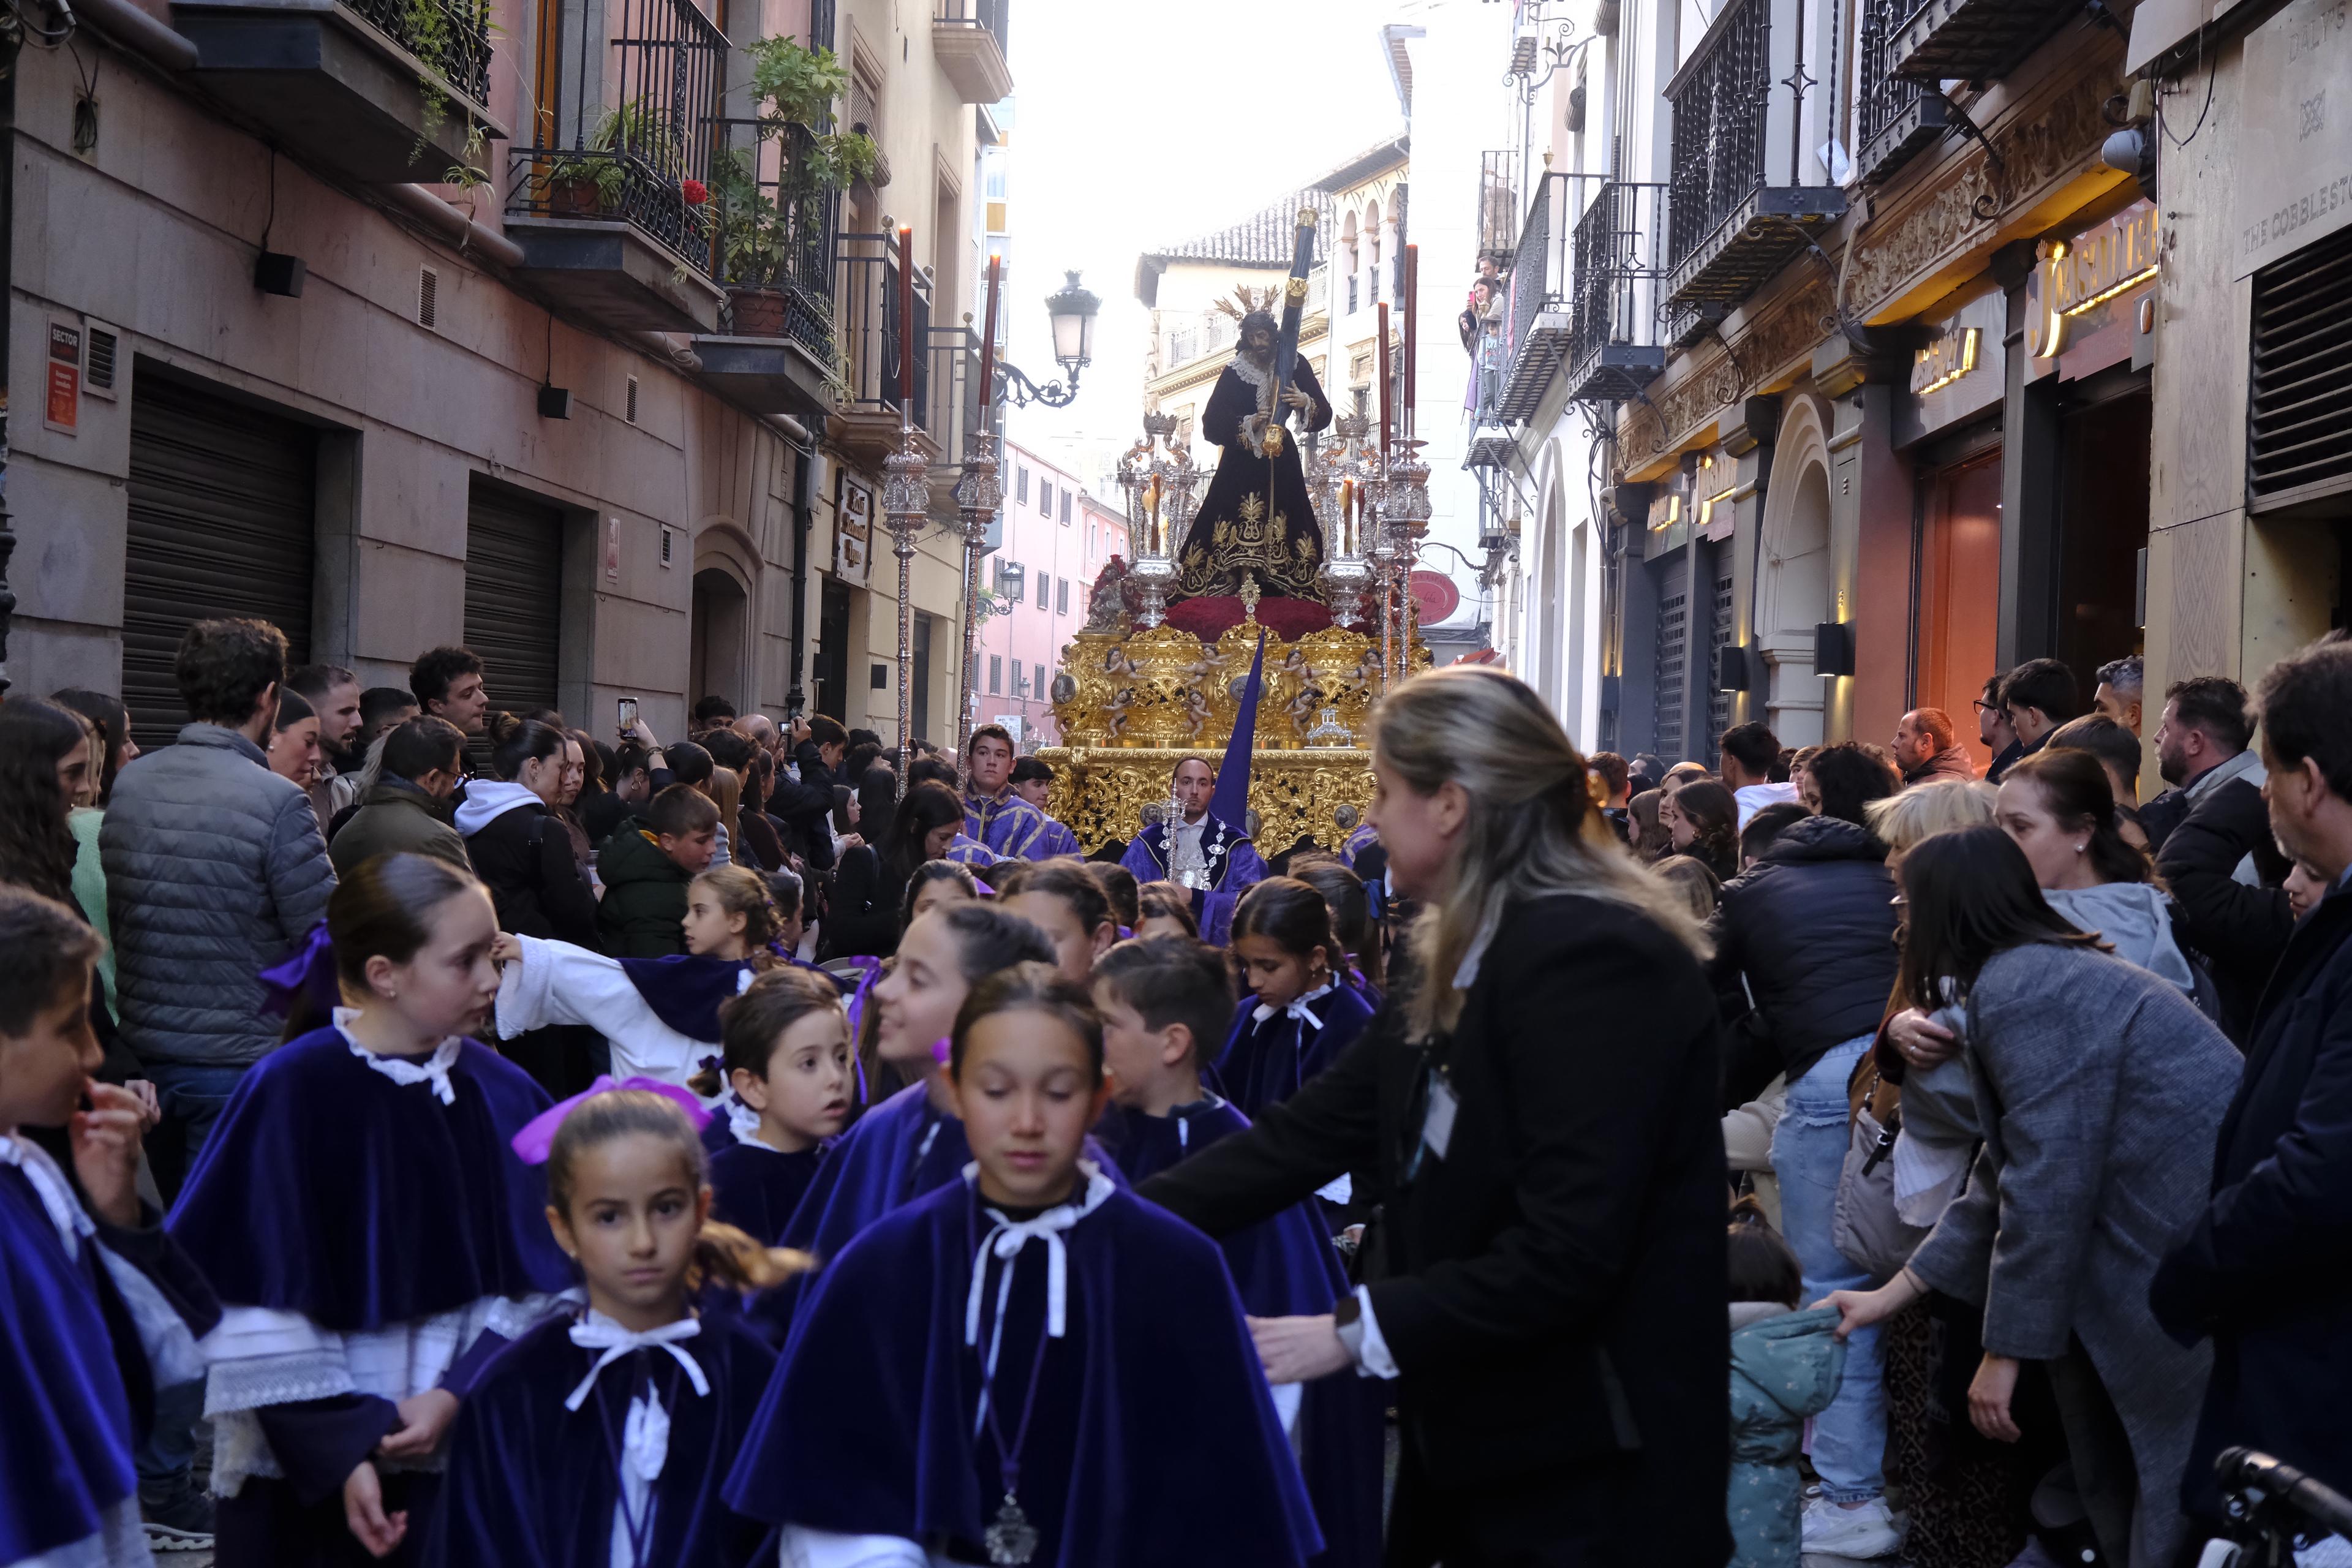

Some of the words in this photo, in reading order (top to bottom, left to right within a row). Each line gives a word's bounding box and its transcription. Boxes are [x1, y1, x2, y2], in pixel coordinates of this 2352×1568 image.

[2243, 219, 2267, 255] THE
[2272, 174, 2352, 241] COBBLEST
[52, 328, 78, 347] SECTOR
